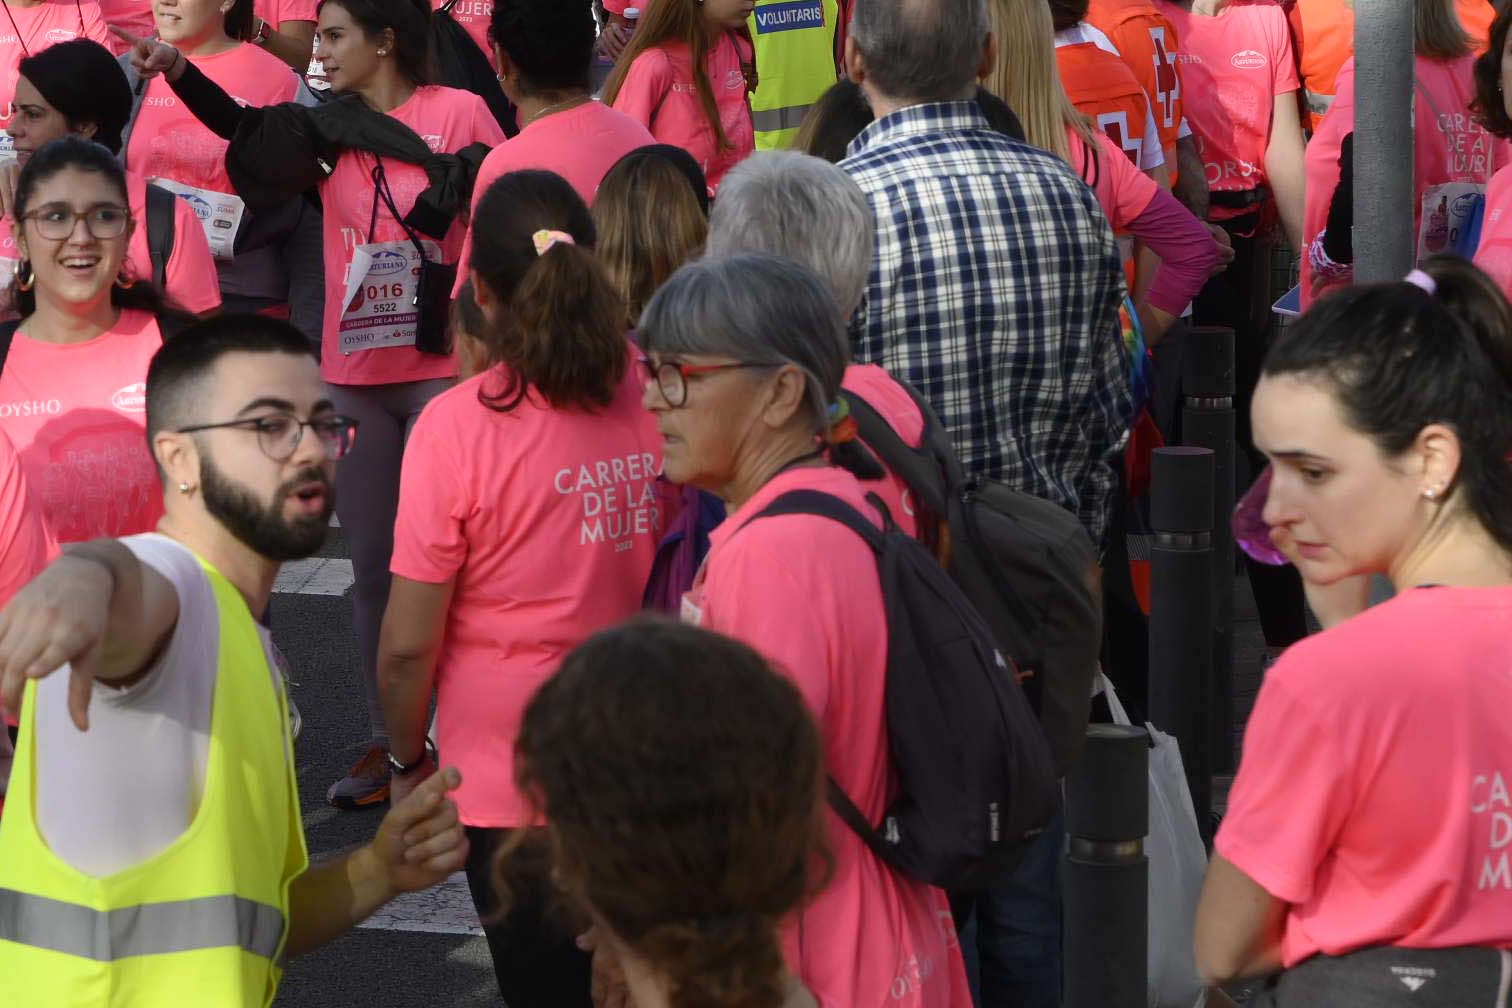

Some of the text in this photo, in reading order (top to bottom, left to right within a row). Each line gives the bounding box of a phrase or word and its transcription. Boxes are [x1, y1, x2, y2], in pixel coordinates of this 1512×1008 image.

[756, 7, 821, 27] VOLUNTARIS
[366, 283, 404, 300] 016
[373, 302, 397, 313] 5522
[344, 333, 375, 345] OYSHO
[583, 484, 656, 517] DE LA
[578, 506, 660, 546] MUJER
[1469, 770, 1512, 815] CA
[1488, 810, 1512, 849] D
